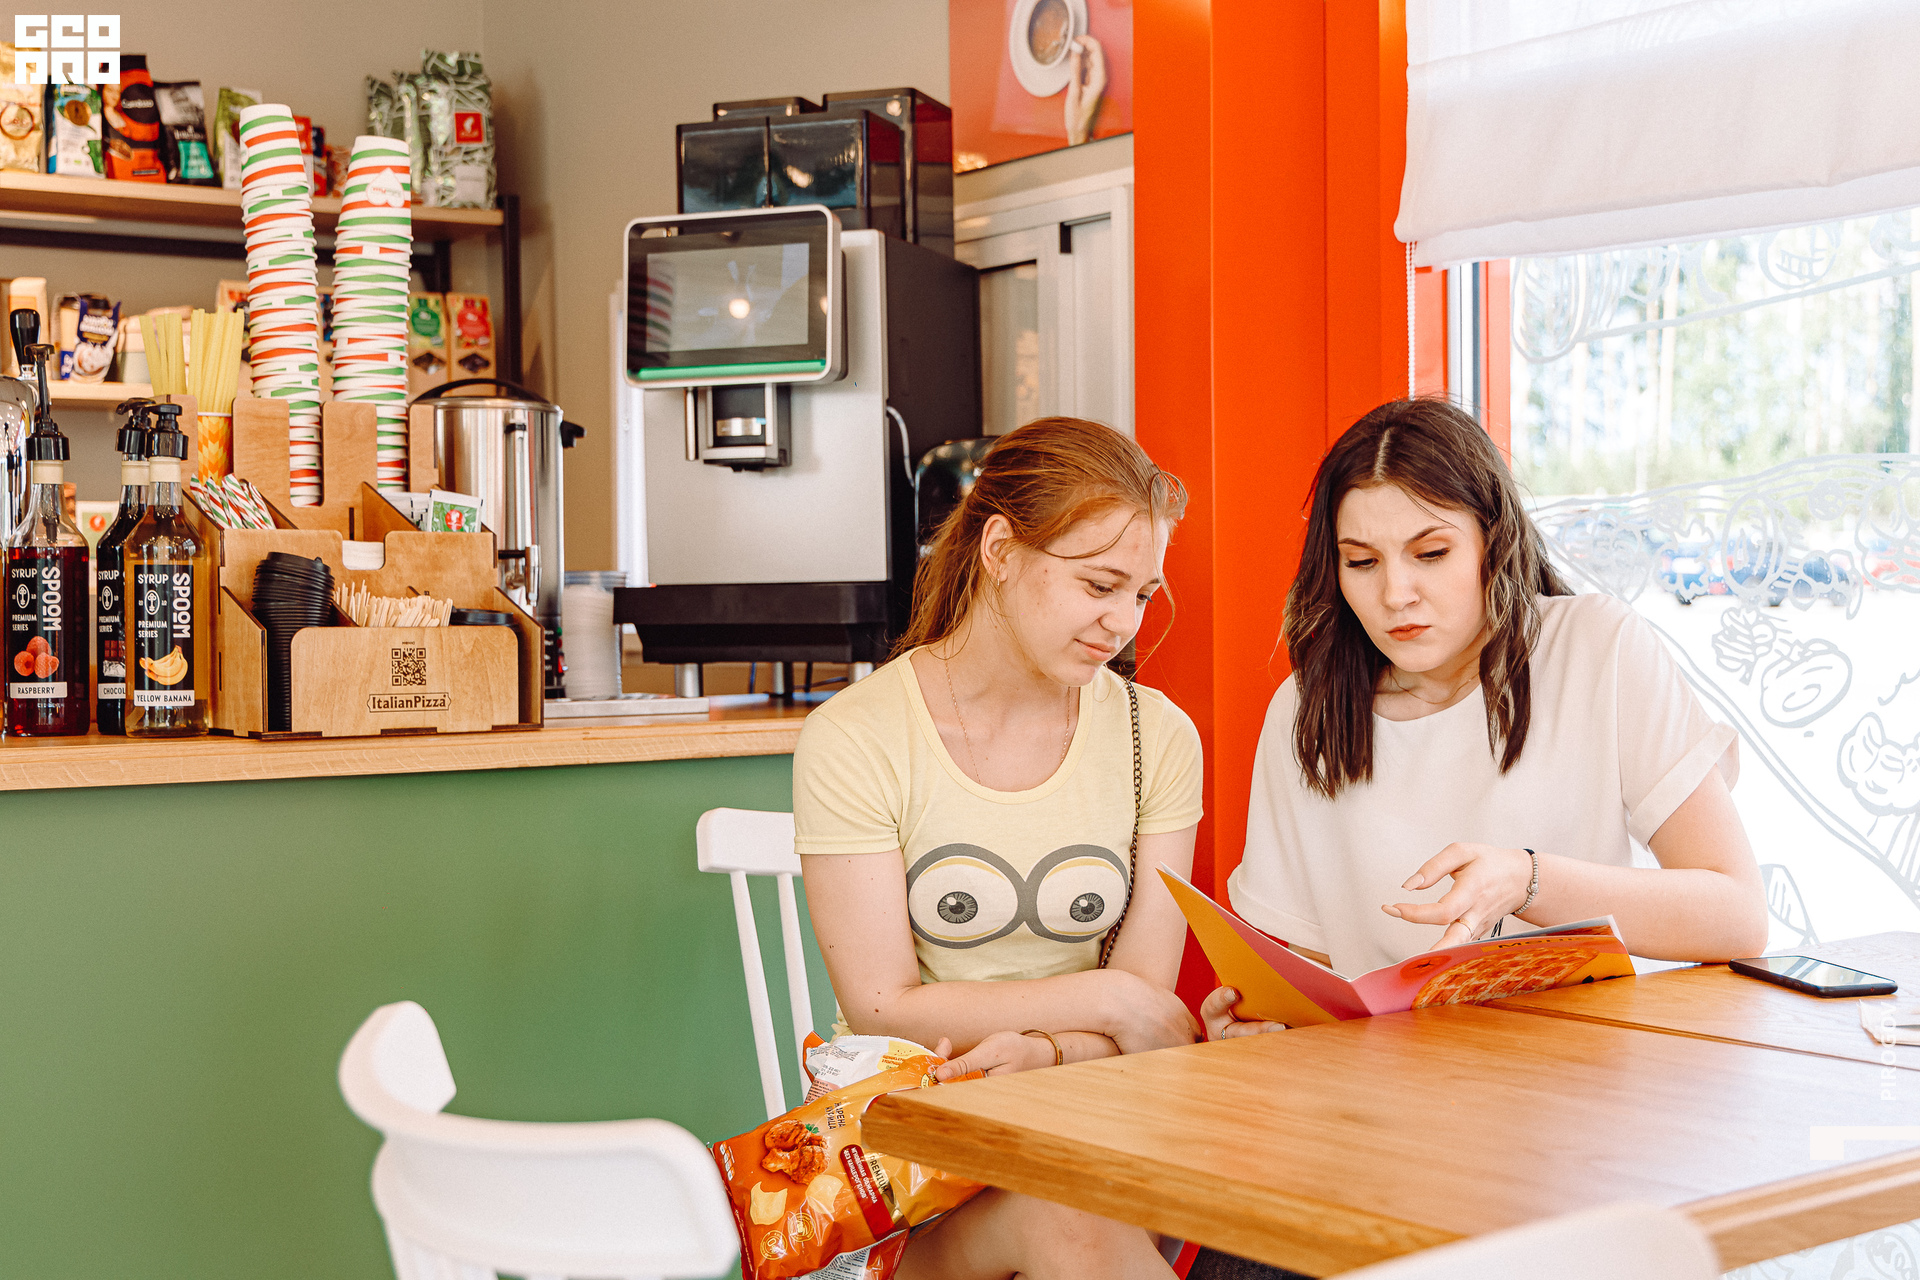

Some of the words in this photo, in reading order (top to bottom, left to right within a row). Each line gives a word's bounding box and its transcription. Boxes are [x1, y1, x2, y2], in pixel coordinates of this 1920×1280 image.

[11, 568, 38, 579] SYRUP
[98, 569, 120, 581] SYRUP
[137, 573, 169, 585] SYRUP
[41, 566, 62, 631] SPOOM
[172, 572, 191, 639] SPOOM
[12, 614, 37, 622] PREMIUM
[12, 623, 29, 631] SERIES
[138, 620, 168, 629] PREMIUM
[138, 630, 159, 638] SERIES
[17, 686, 55, 694] RASPBERRY
[136, 694, 161, 702] YELLOW
[163, 694, 192, 702] BANANA
[372, 695, 446, 709] ItalianPizza
[869, 1155, 889, 1193] PREMIUM
